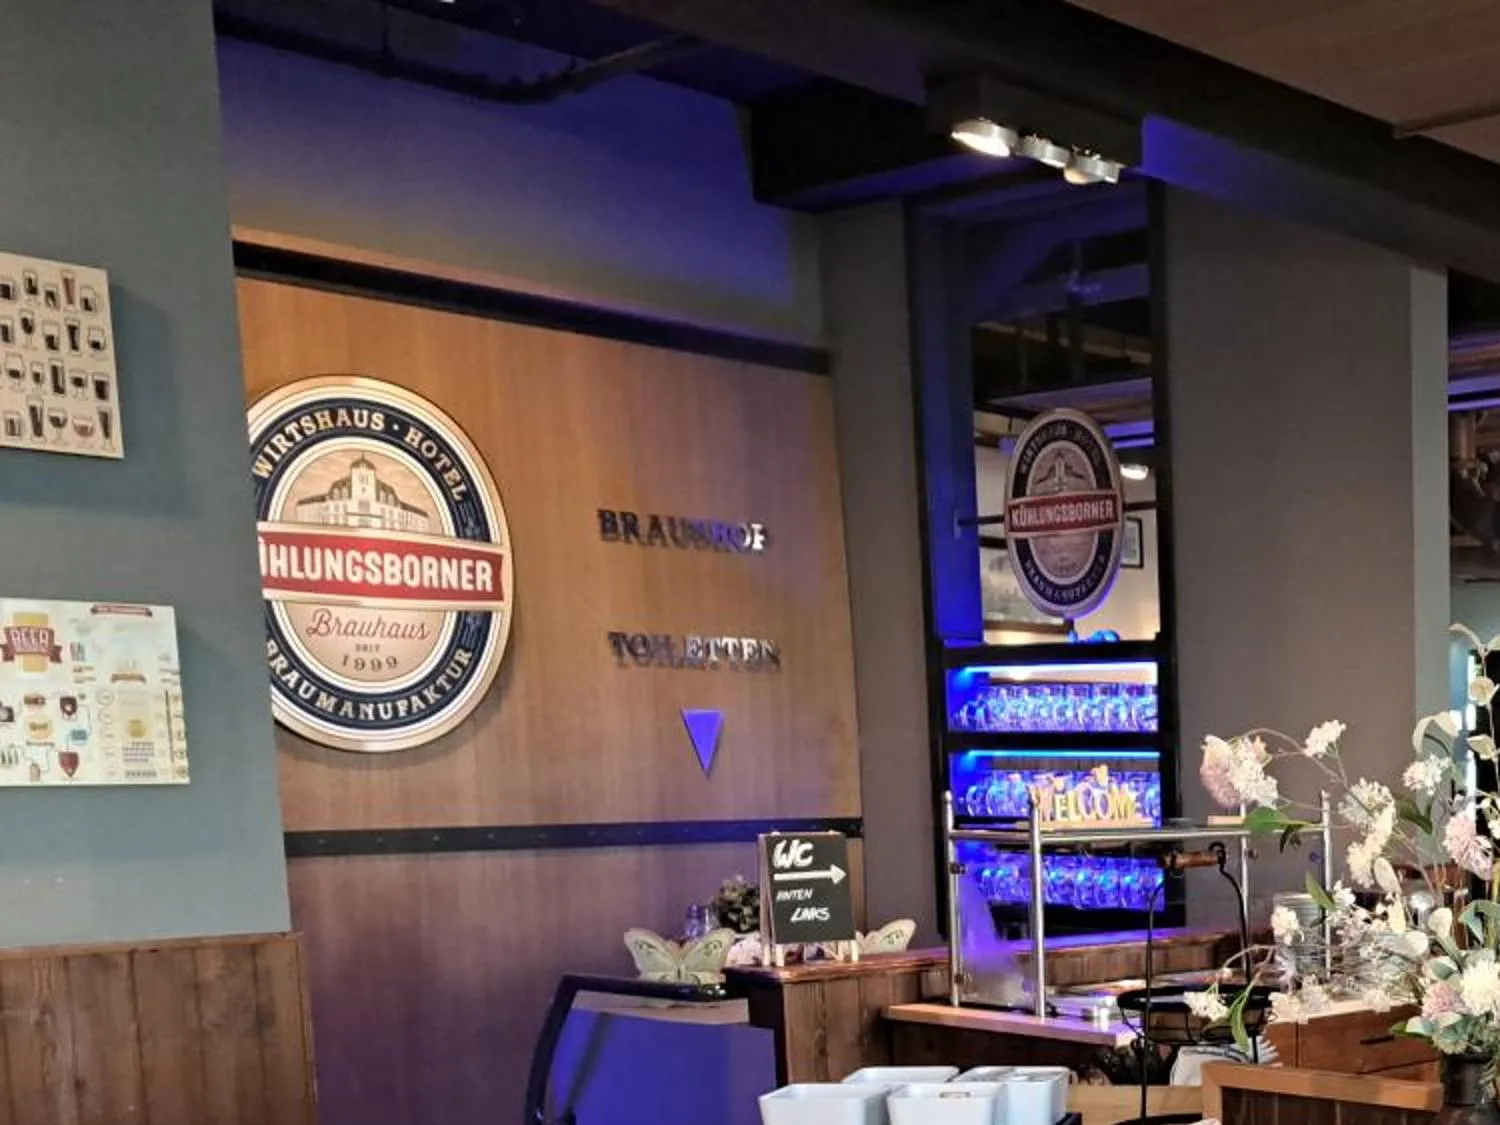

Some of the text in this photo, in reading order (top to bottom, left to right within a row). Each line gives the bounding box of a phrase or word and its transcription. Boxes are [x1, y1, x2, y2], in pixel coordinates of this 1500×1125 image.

[252, 408, 468, 502] WIRTSHAUS HOTEL
[258, 536, 493, 592] HLUNGSBORNER
[305, 608, 431, 641] Brauhaus
[608, 631, 780, 671] TOILETTEN
[773, 839, 814, 869] WC
[790, 907, 831, 923] LINKS
